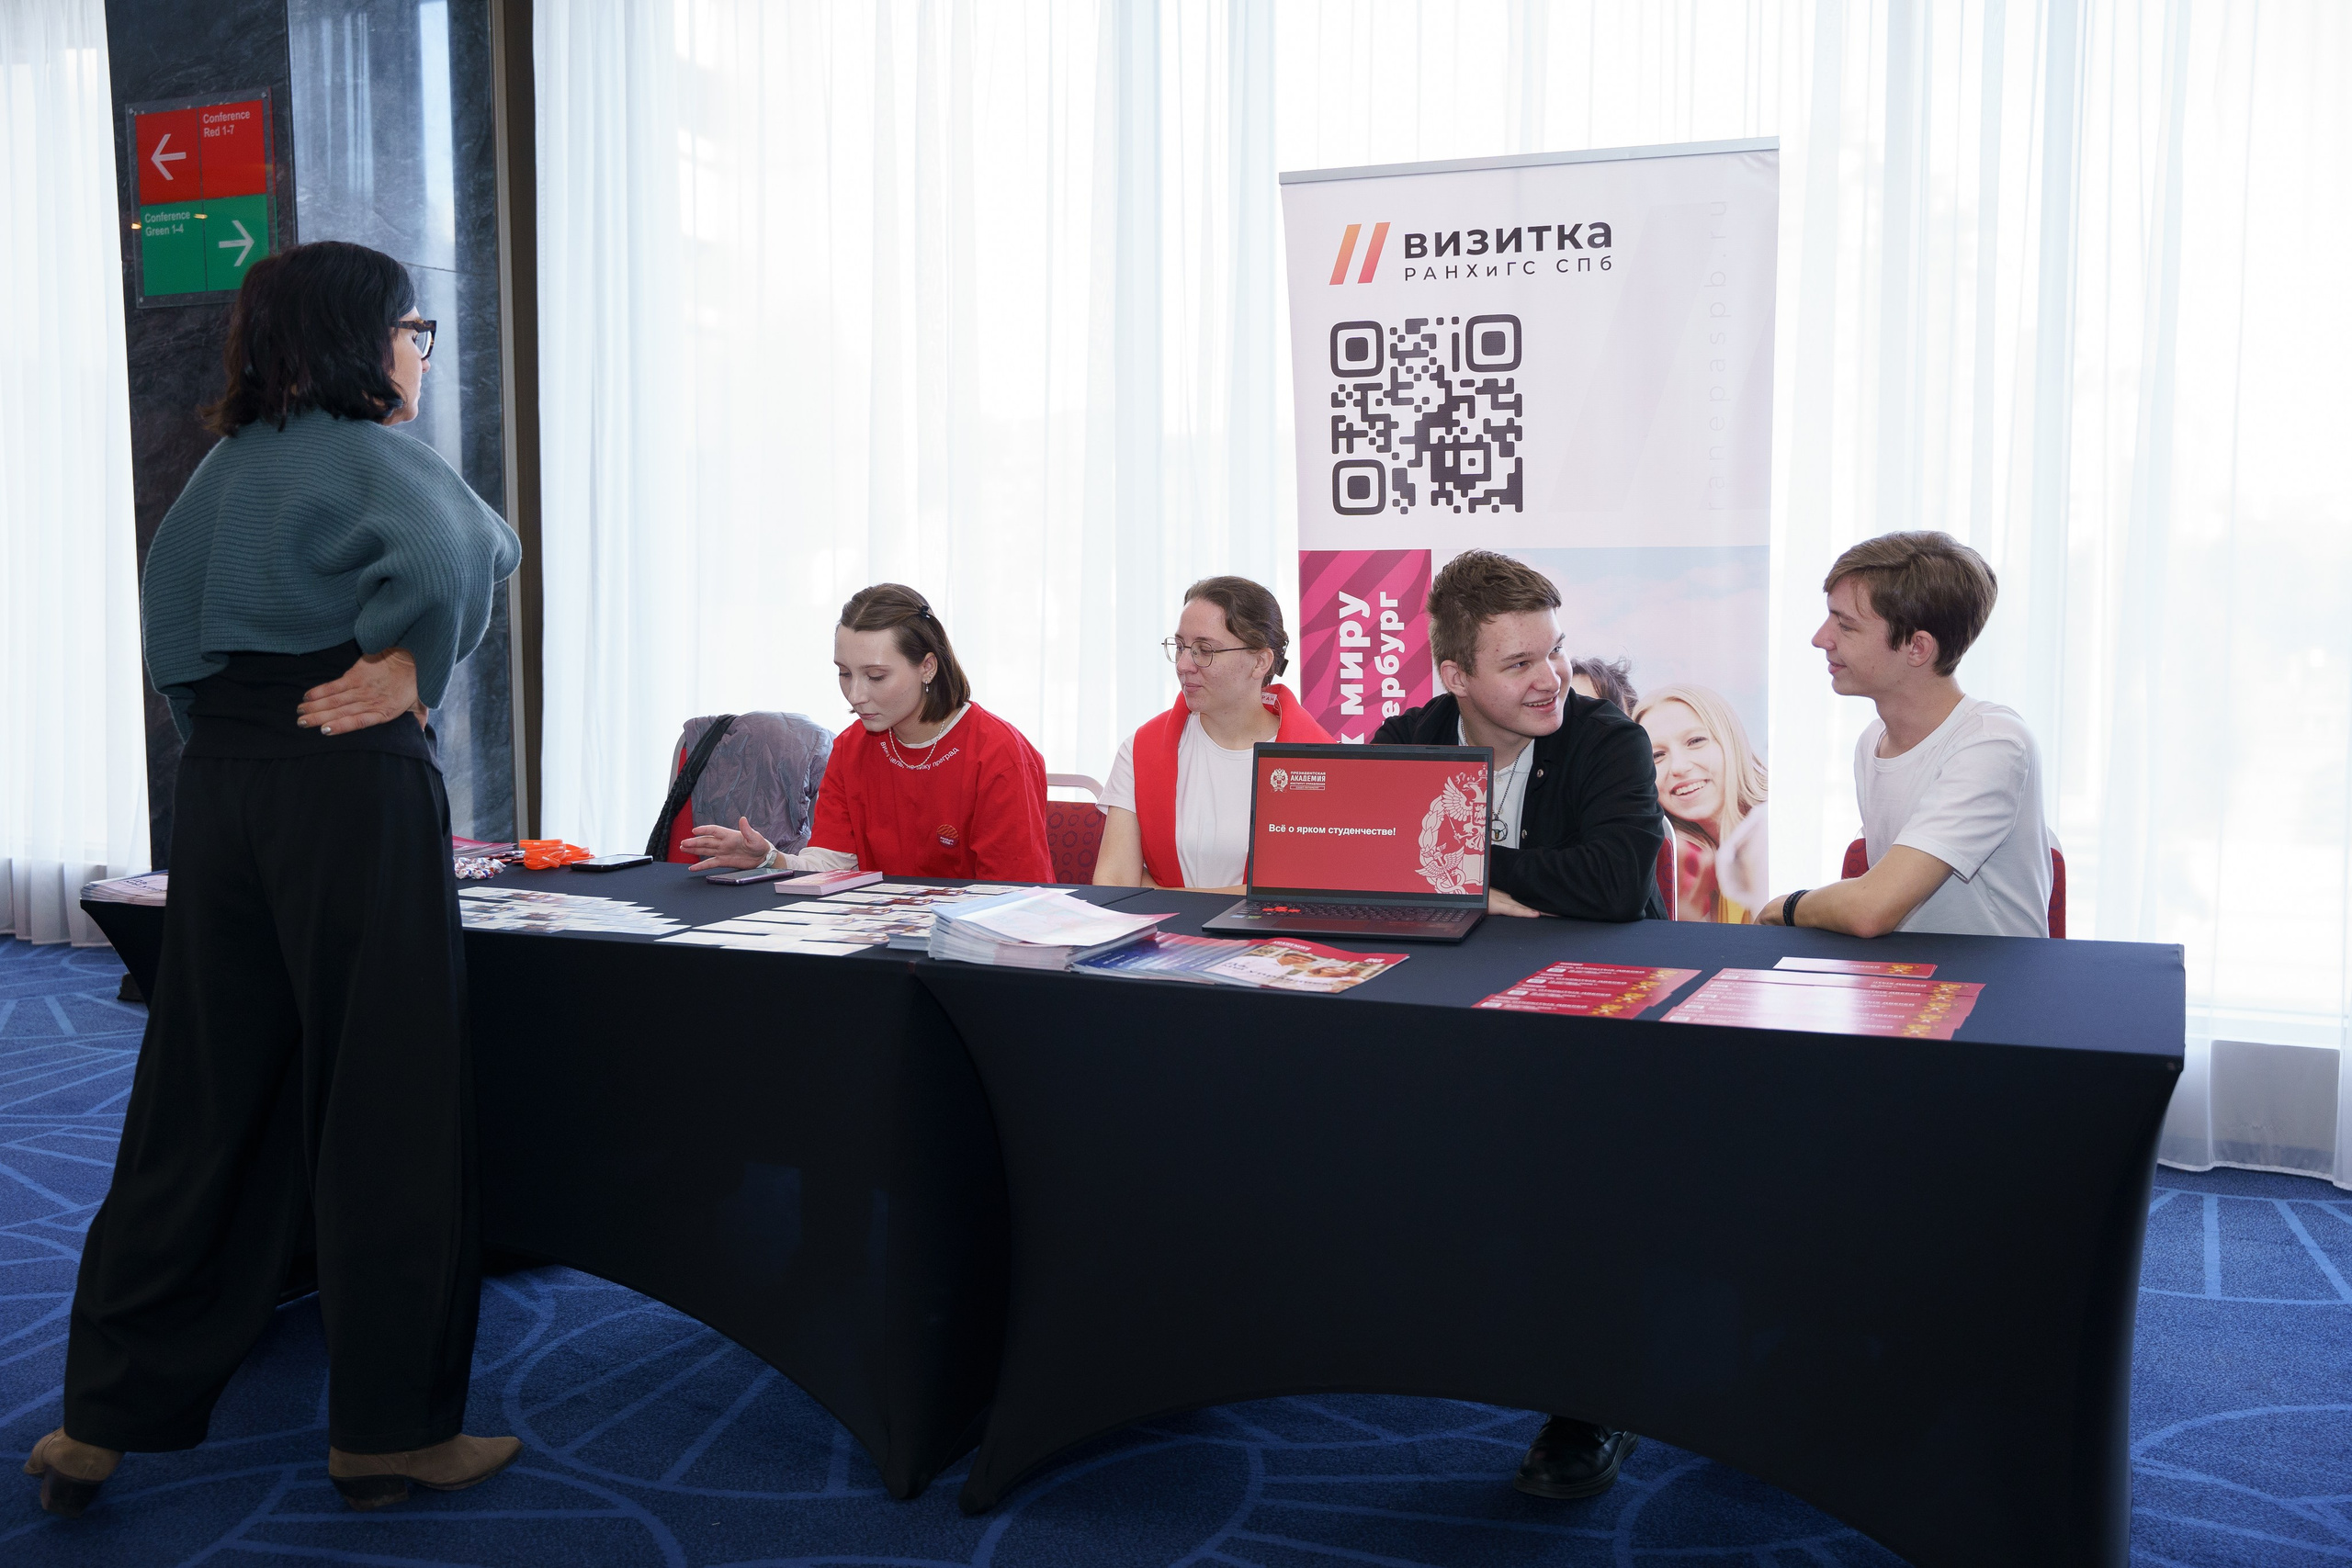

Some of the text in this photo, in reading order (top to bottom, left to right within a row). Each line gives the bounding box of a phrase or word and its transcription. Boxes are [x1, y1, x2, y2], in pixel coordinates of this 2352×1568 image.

[203, 111, 251, 124] Conference
[203, 124, 235, 138] Red 1-7
[145, 211, 191, 223] Conference
[145, 223, 185, 237] Green 1-4
[1404, 221, 1612, 259] визитка
[1405, 254, 1612, 282] РАНХиГС СПб
[1704, 201, 1731, 512] ranepaspb.ru
[1339, 591, 1371, 716] миру
[1374, 592, 1406, 725] ербург
[1268, 823, 1286, 832] Всё
[1296, 825, 1326, 835] ярком
[1328, 826, 1396, 836] студенчестве!
